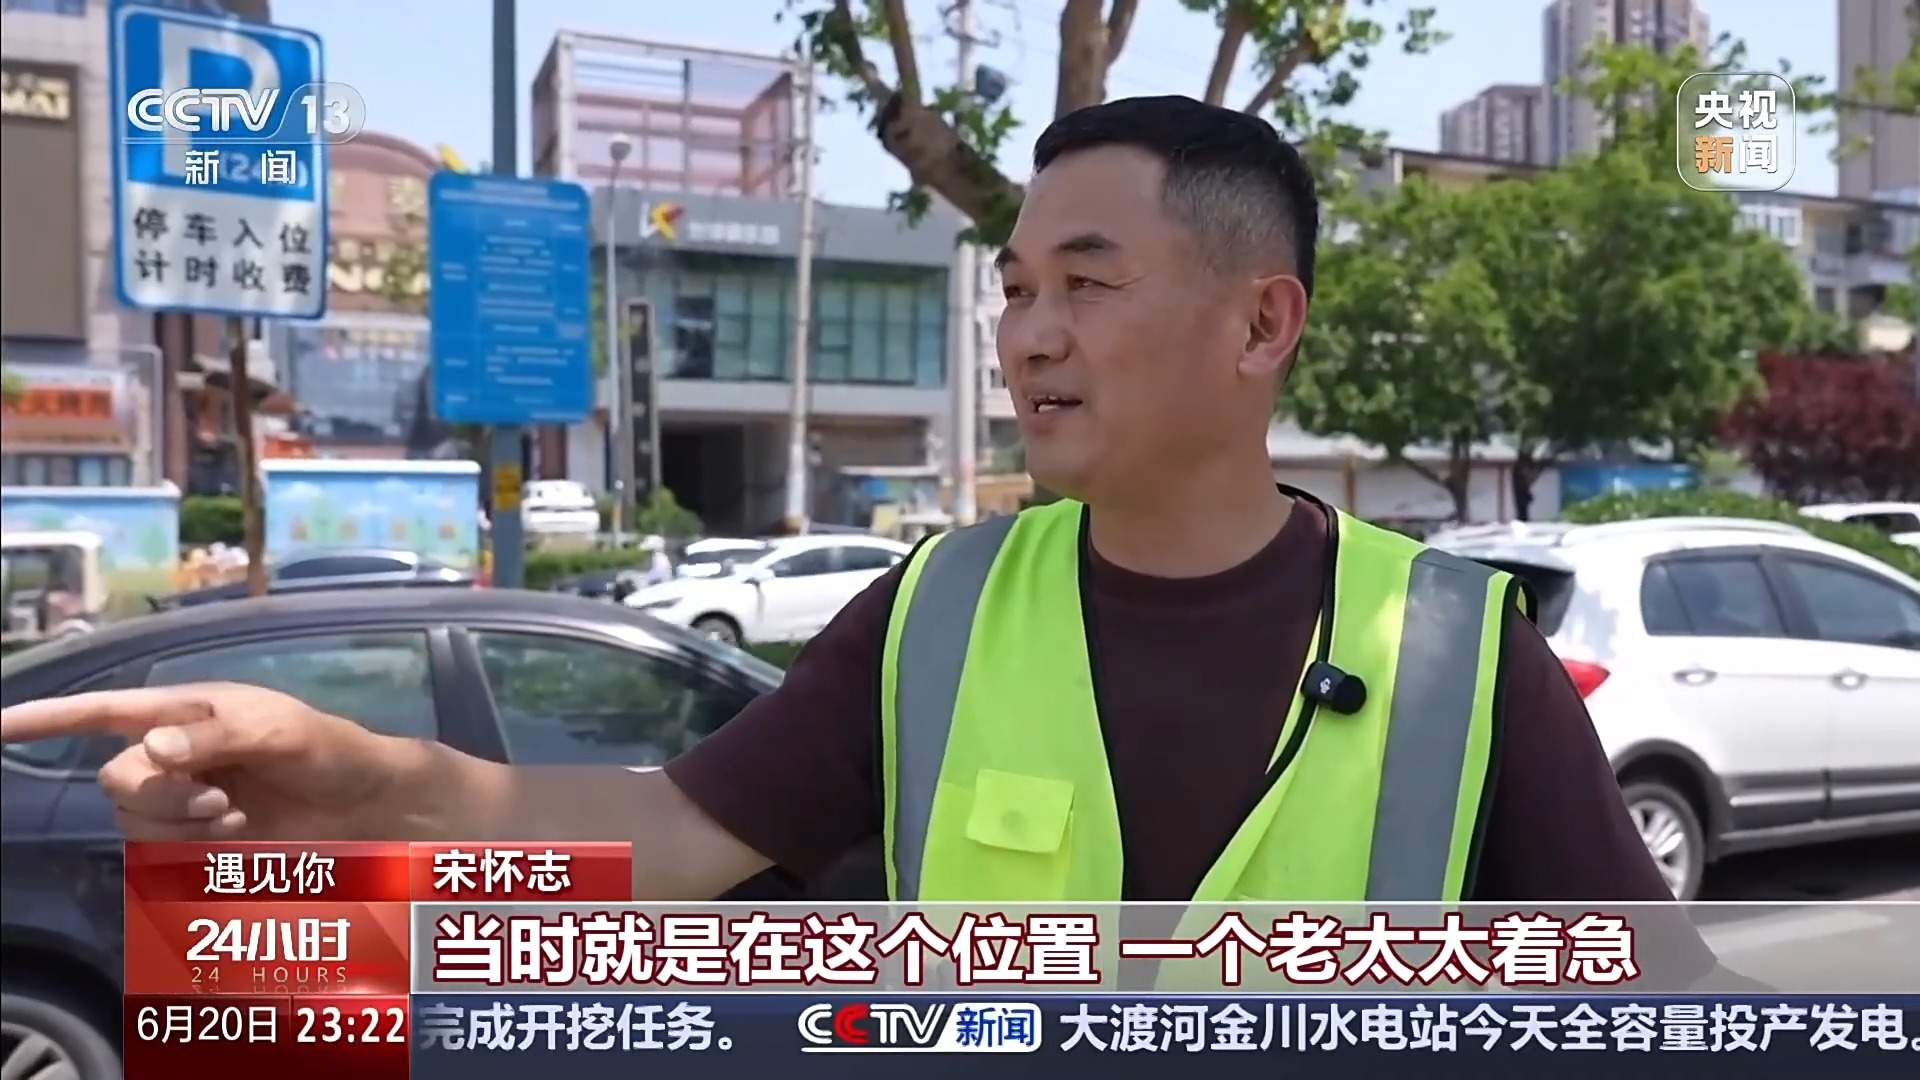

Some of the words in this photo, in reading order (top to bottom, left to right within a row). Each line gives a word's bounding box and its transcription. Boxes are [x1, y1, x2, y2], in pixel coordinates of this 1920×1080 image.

[159, 20, 280, 178] P
[134, 207, 312, 254] 停车入位
[135, 250, 312, 294] 计时收费
